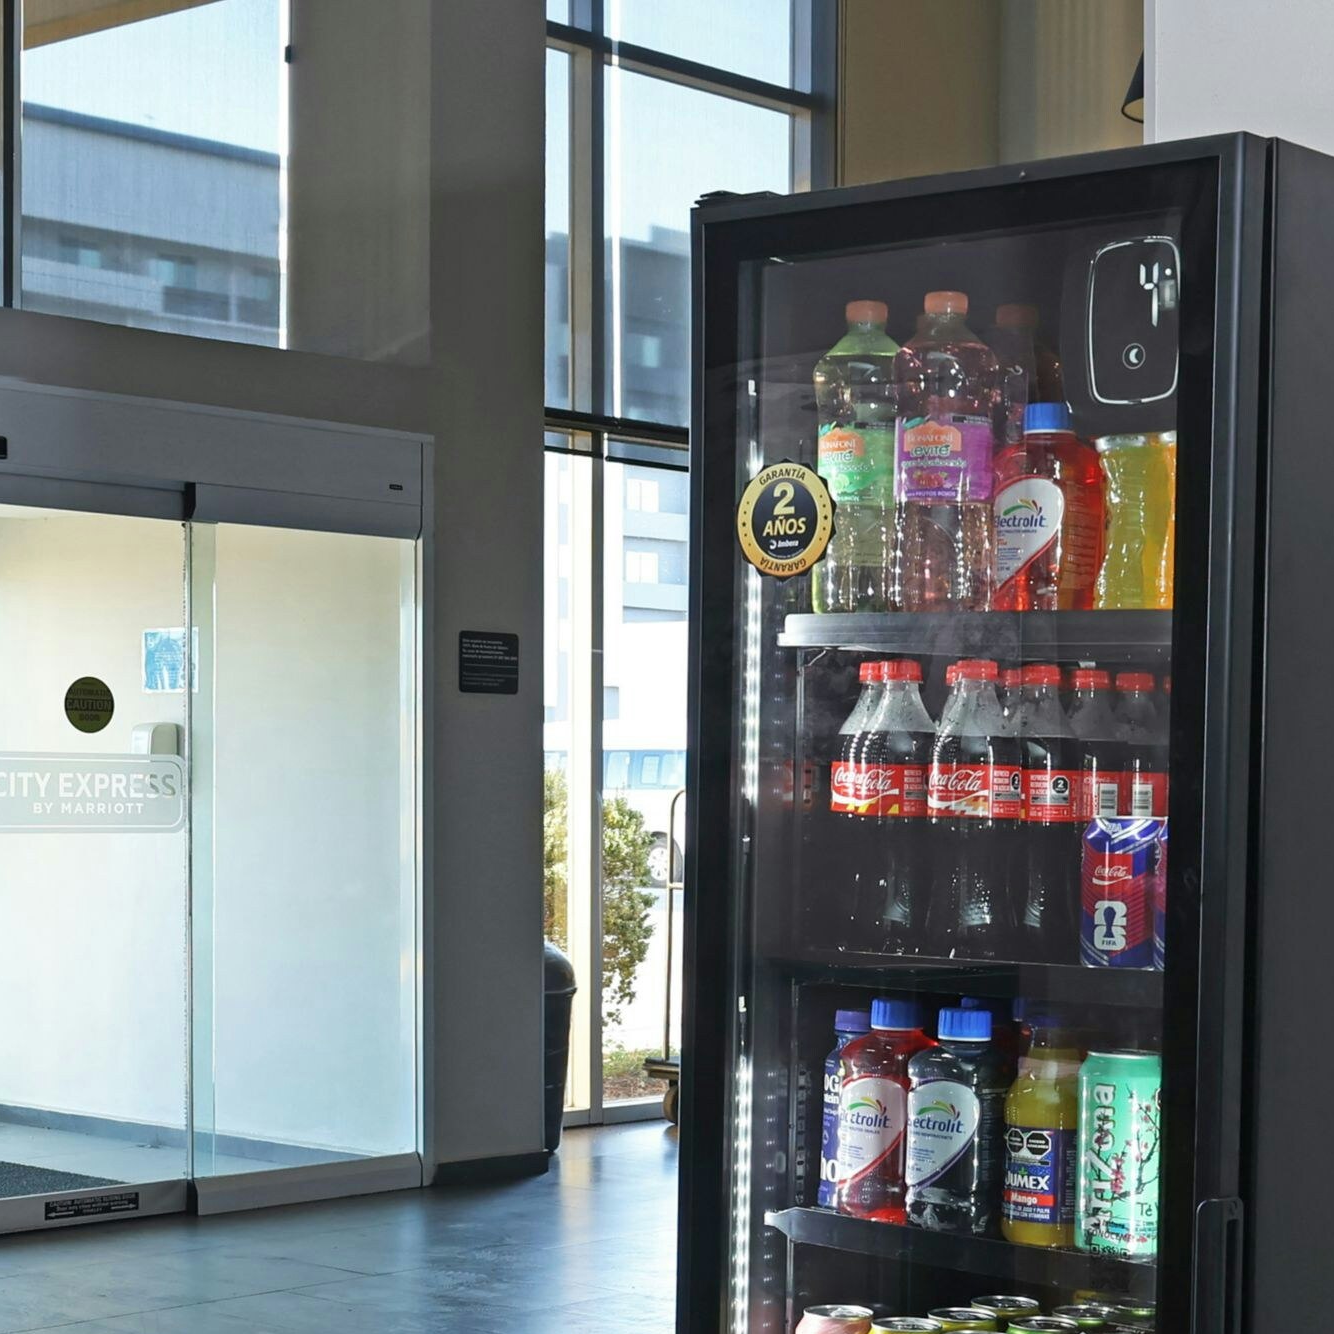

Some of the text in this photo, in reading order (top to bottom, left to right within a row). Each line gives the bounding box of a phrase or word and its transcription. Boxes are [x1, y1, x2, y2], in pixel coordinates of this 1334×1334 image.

[759, 467, 806, 486] GARANTÍA
[773, 481, 795, 516] 2
[762, 516, 807, 537] AÑOS
[759, 556, 807, 573] GARANTÍA
[67, 699, 112, 711] CAUTION
[58, 772, 176, 799] EXPRESS
[1057, 779, 1065, 788] 2
[33, 802, 144, 815] BY MARRIOTT
[1101, 939, 1117, 947] FIFA
[1006, 1170, 1050, 1191] JUMEX
[1010, 1191, 1038, 1206] Mango
